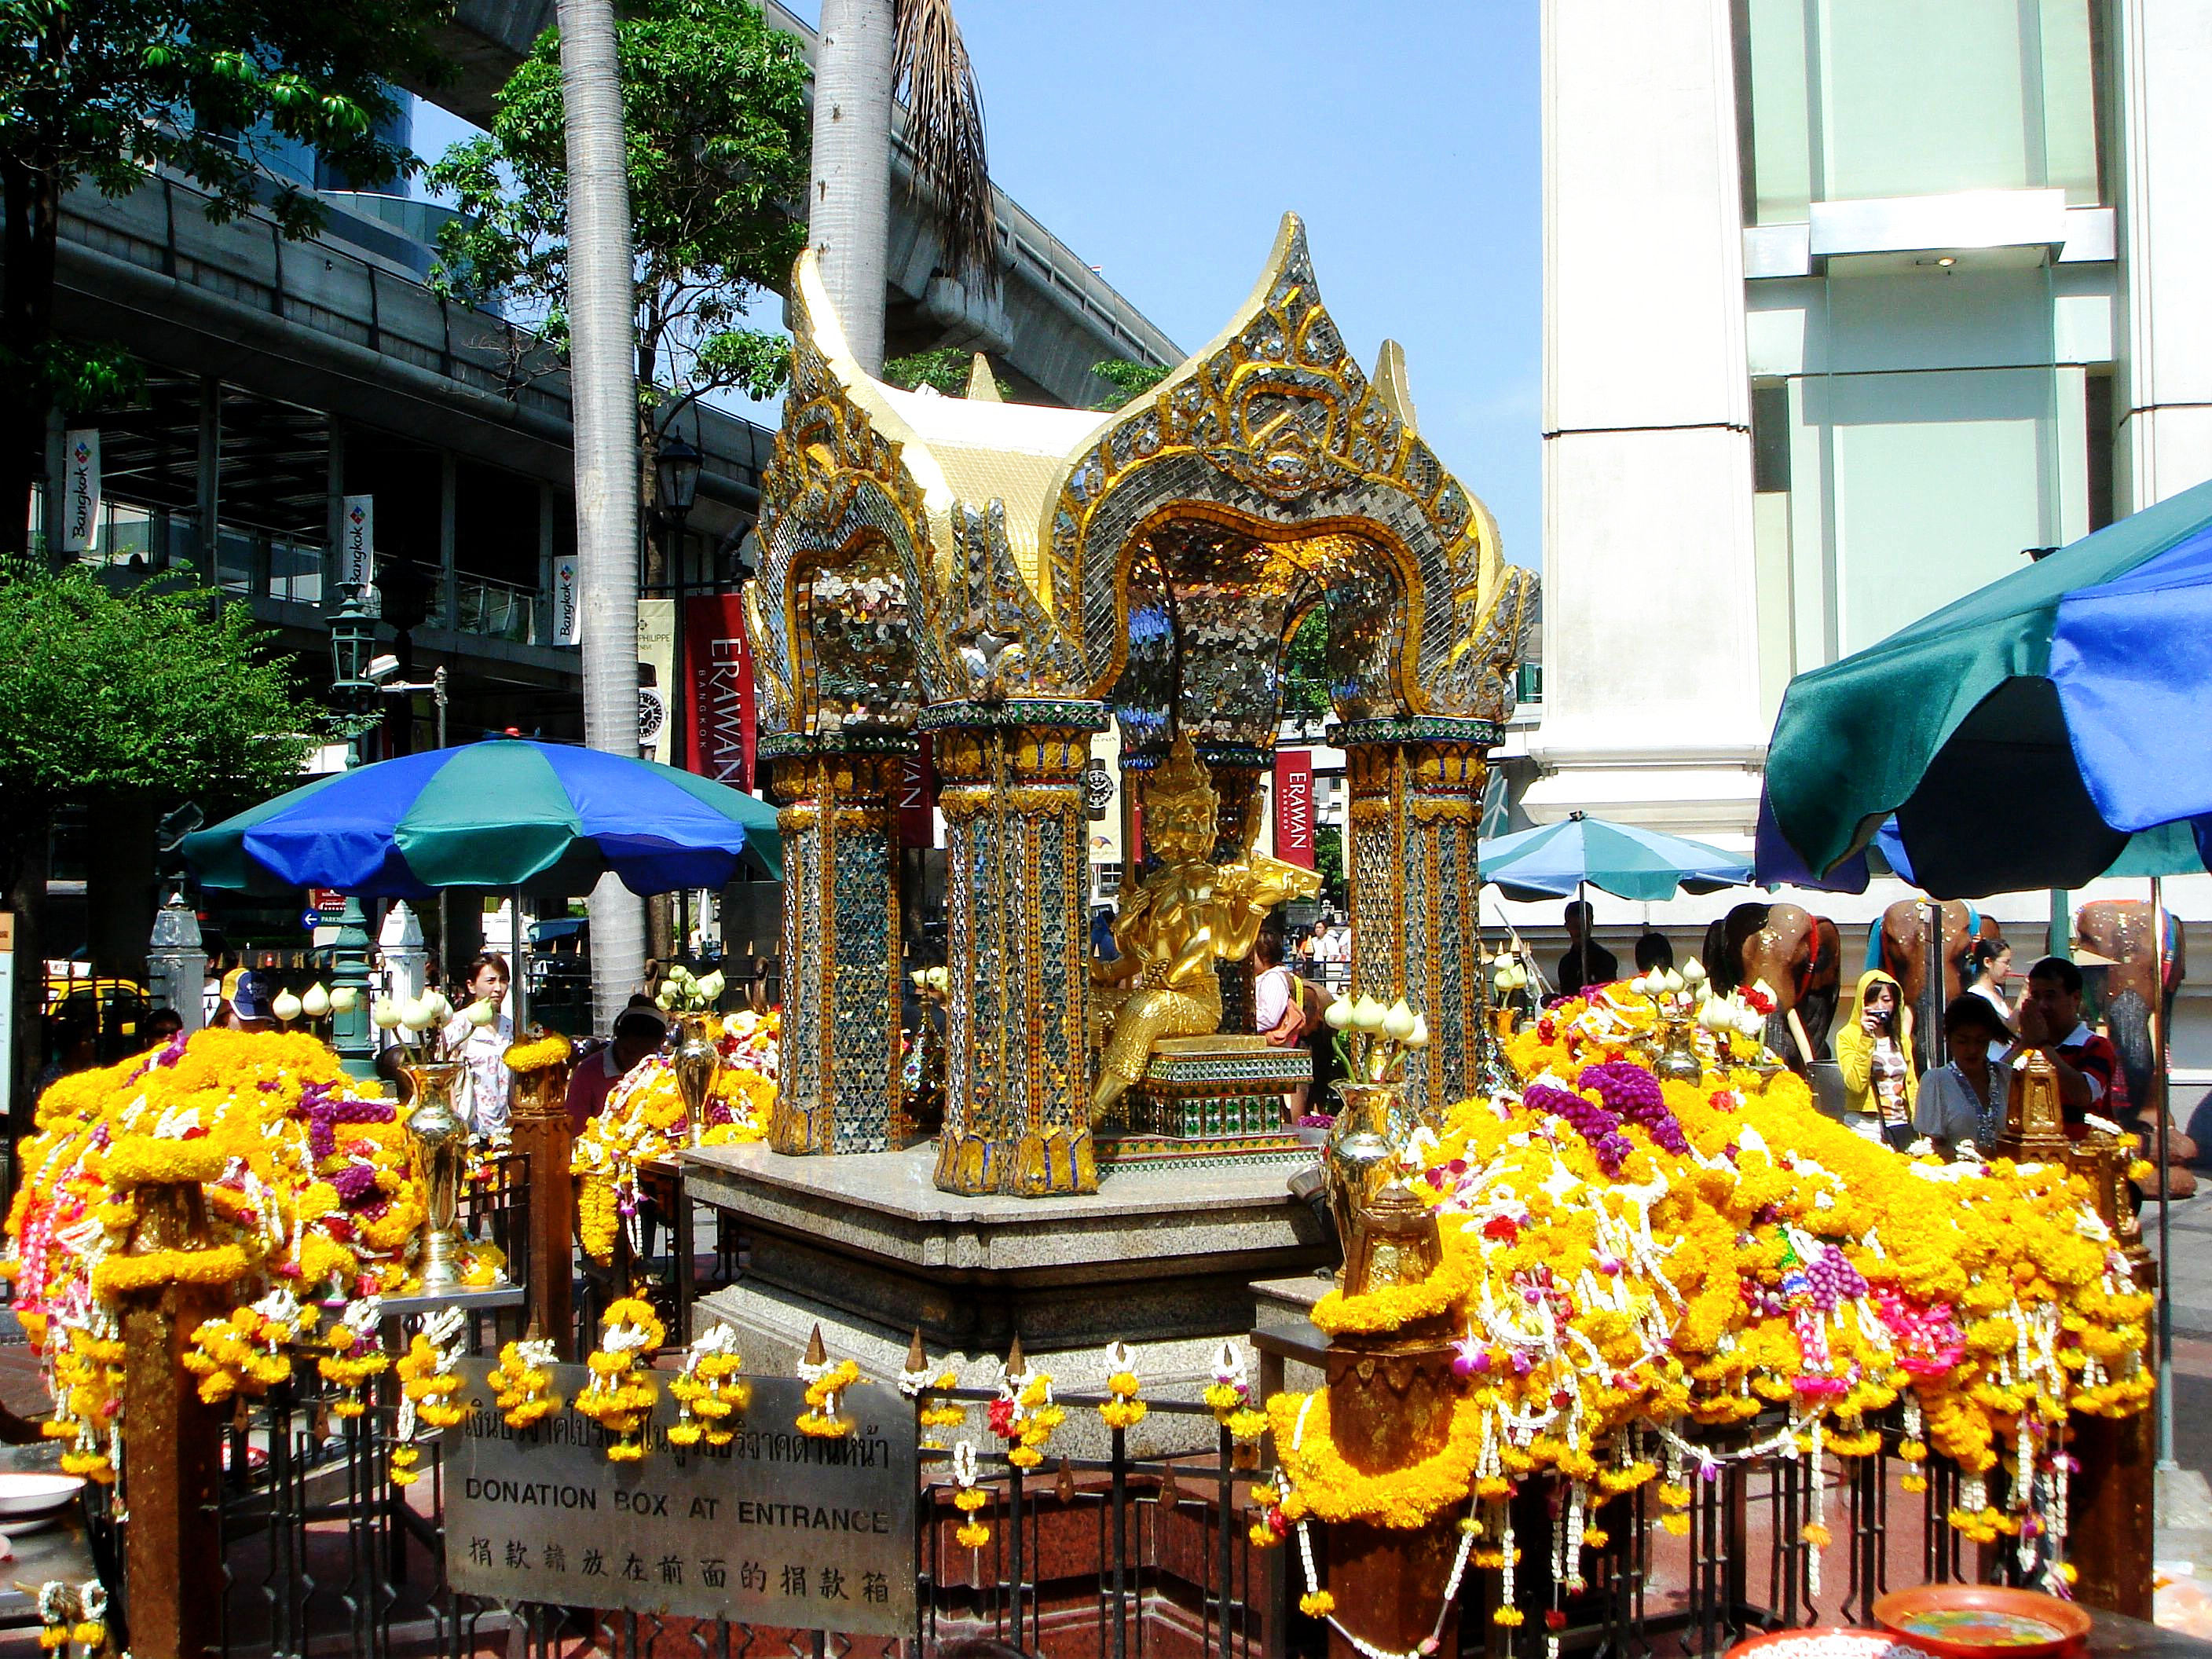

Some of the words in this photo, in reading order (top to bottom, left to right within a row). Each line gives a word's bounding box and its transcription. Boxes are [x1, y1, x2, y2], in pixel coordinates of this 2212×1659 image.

[71, 465, 92, 540] Bangkok
[349, 526, 367, 583] Bangkok
[559, 583, 575, 637] Bangkok
[639, 634, 670, 643] PHILIPPE
[698, 669, 707, 749] BANGKOK
[709, 638, 742, 783] ERAWAN
[1288, 772, 1307, 848] ERAWAN
[465, 1478, 597, 1511] DONATION
[614, 1490, 669, 1517] BOX
[689, 1496, 720, 1521] AT
[738, 1500, 889, 1534] ENTRANCE
[468, 1536, 890, 1604] 捐款請放在前面的捐款箱
